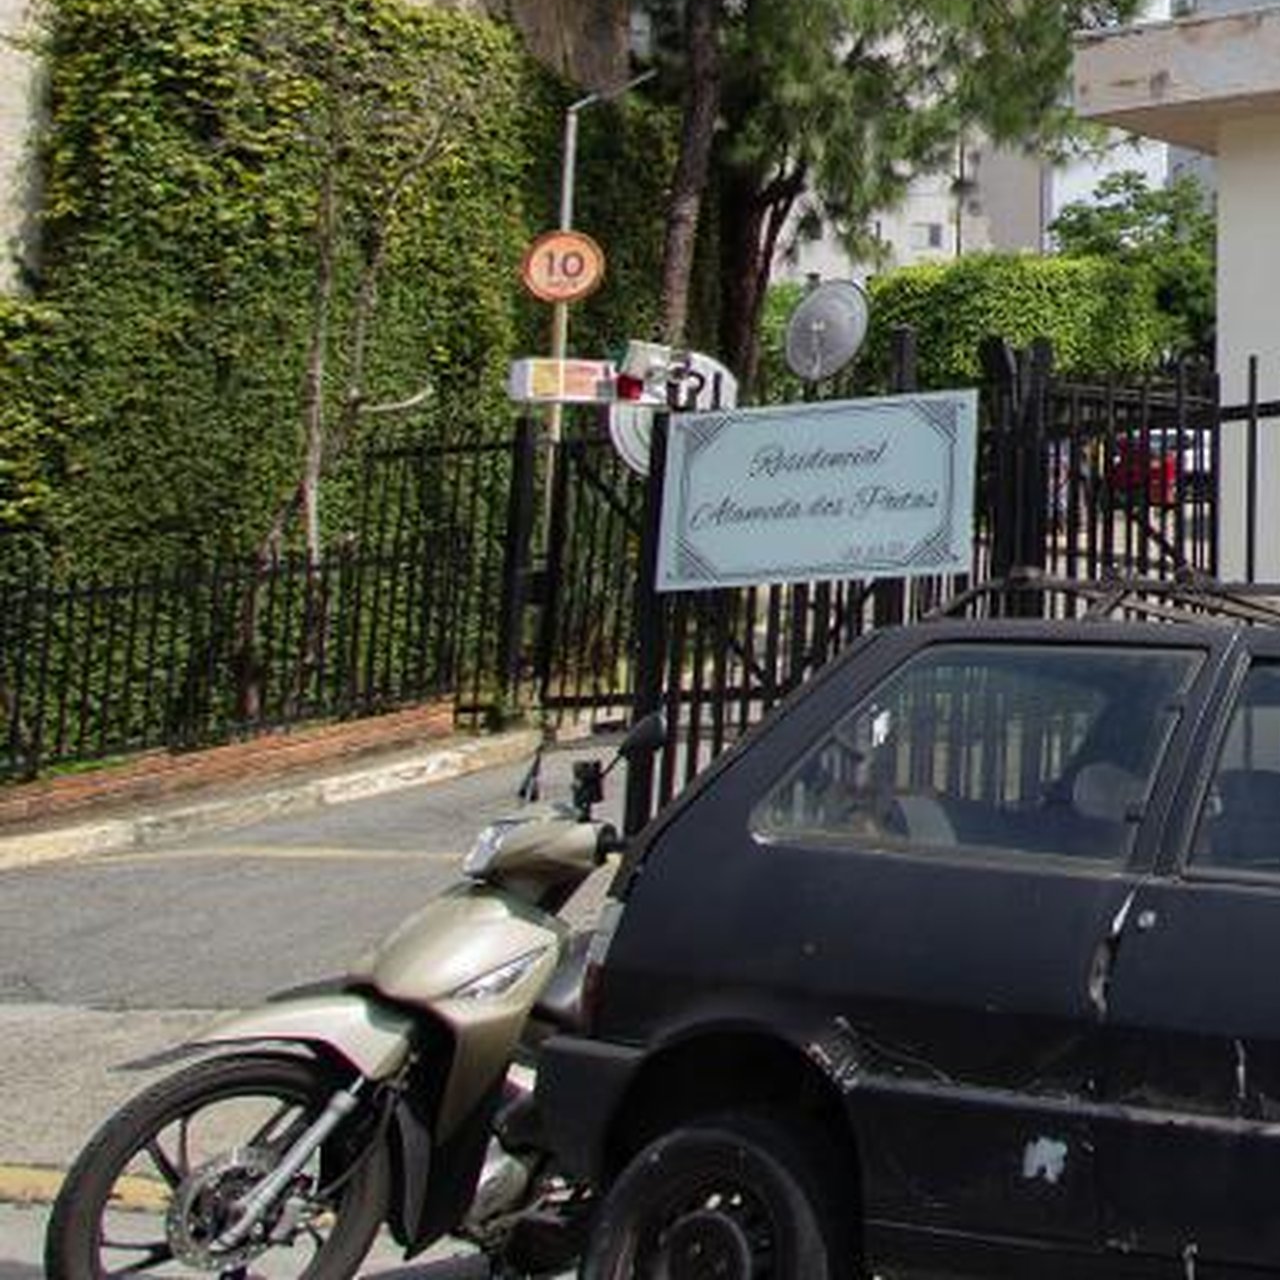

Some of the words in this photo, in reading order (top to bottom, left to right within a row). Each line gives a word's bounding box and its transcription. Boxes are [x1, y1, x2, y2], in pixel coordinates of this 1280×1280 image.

[545, 250, 585, 278] 10
[748, 439, 889, 478] Residencial
[689, 494, 801, 530] Alameda
